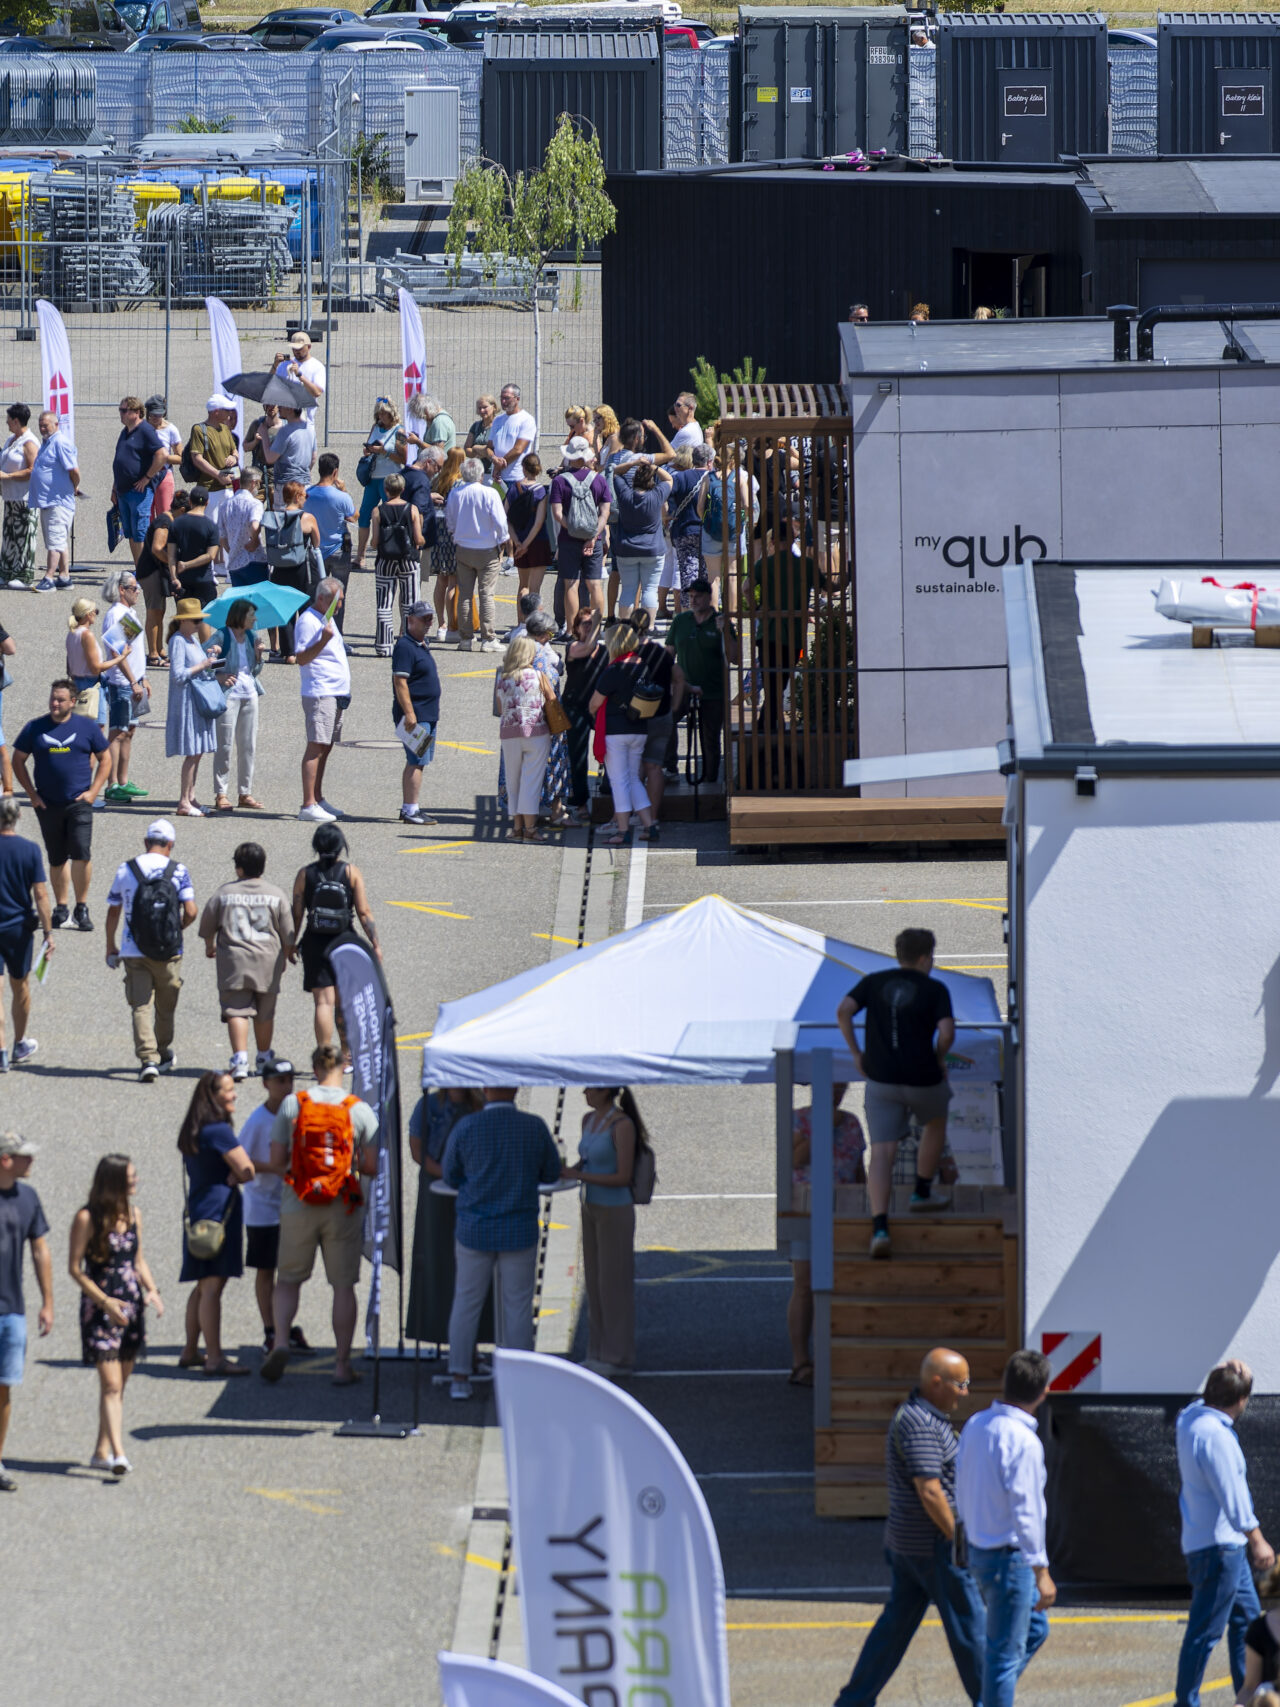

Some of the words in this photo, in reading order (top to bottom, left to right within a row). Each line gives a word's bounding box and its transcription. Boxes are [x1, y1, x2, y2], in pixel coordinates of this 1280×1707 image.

[870, 47, 887, 55] RFBU
[1007, 94, 1029, 105] Bakery
[1225, 94, 1246, 104] Bakery
[914, 535, 941, 551] my
[942, 524, 1048, 579] qub
[915, 581, 1000, 593] sustainable.
[221, 893, 281, 908] BROOKLYN
